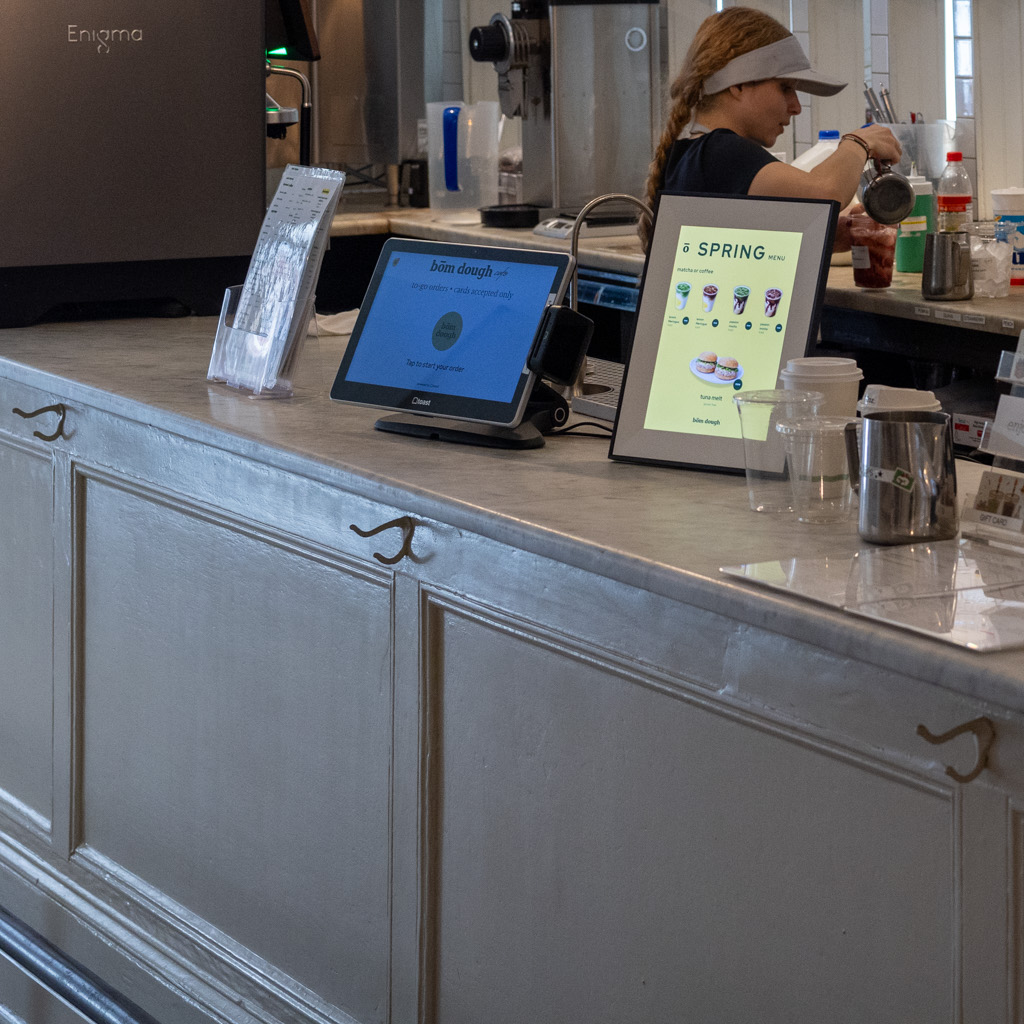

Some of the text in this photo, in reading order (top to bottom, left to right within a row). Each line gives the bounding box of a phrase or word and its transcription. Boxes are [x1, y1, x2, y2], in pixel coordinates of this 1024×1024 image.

[67, 24, 143, 54] Enigma
[698, 241, 766, 260] SPRING
[767, 254, 786, 262] MENU
[430, 259, 455, 274] bōm
[457, 262, 493, 280] dough
[677, 266, 693, 274] matcha
[411, 281, 514, 301] to-go orders cards accepted only
[406, 358, 465, 374] Tap to start your order
[417, 398, 432, 407] toast
[704, 418, 721, 427] dough
[980, 514, 1008, 527] GIFT CARD
